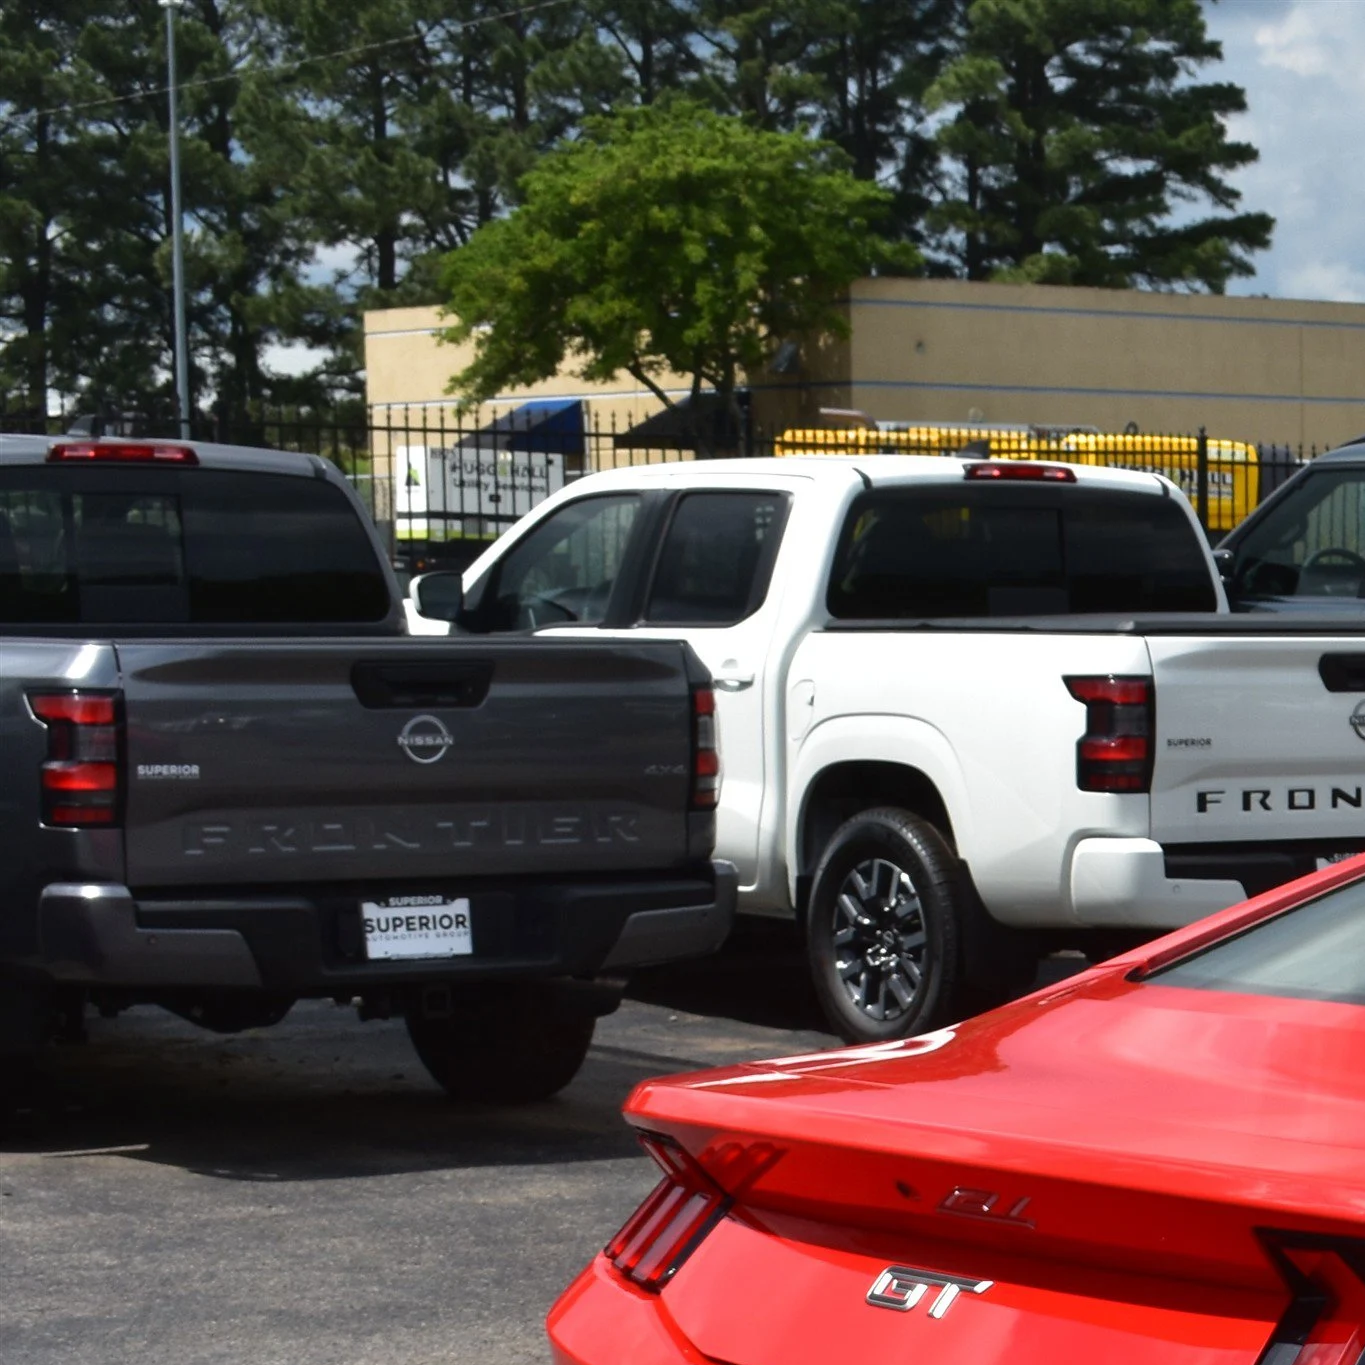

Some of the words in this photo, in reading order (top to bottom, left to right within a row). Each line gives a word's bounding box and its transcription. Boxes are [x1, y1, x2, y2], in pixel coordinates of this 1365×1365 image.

[397, 735, 454, 746] NISSAN
[1167, 737, 1212, 747] SUPERIOR
[137, 764, 200, 775] SUPERIOR
[183, 816, 640, 854] FRONTIER
[388, 895, 443, 907] SUPERIOR
[364, 914, 468, 934] SUPERIOR
[866, 1265, 994, 1319] GT
